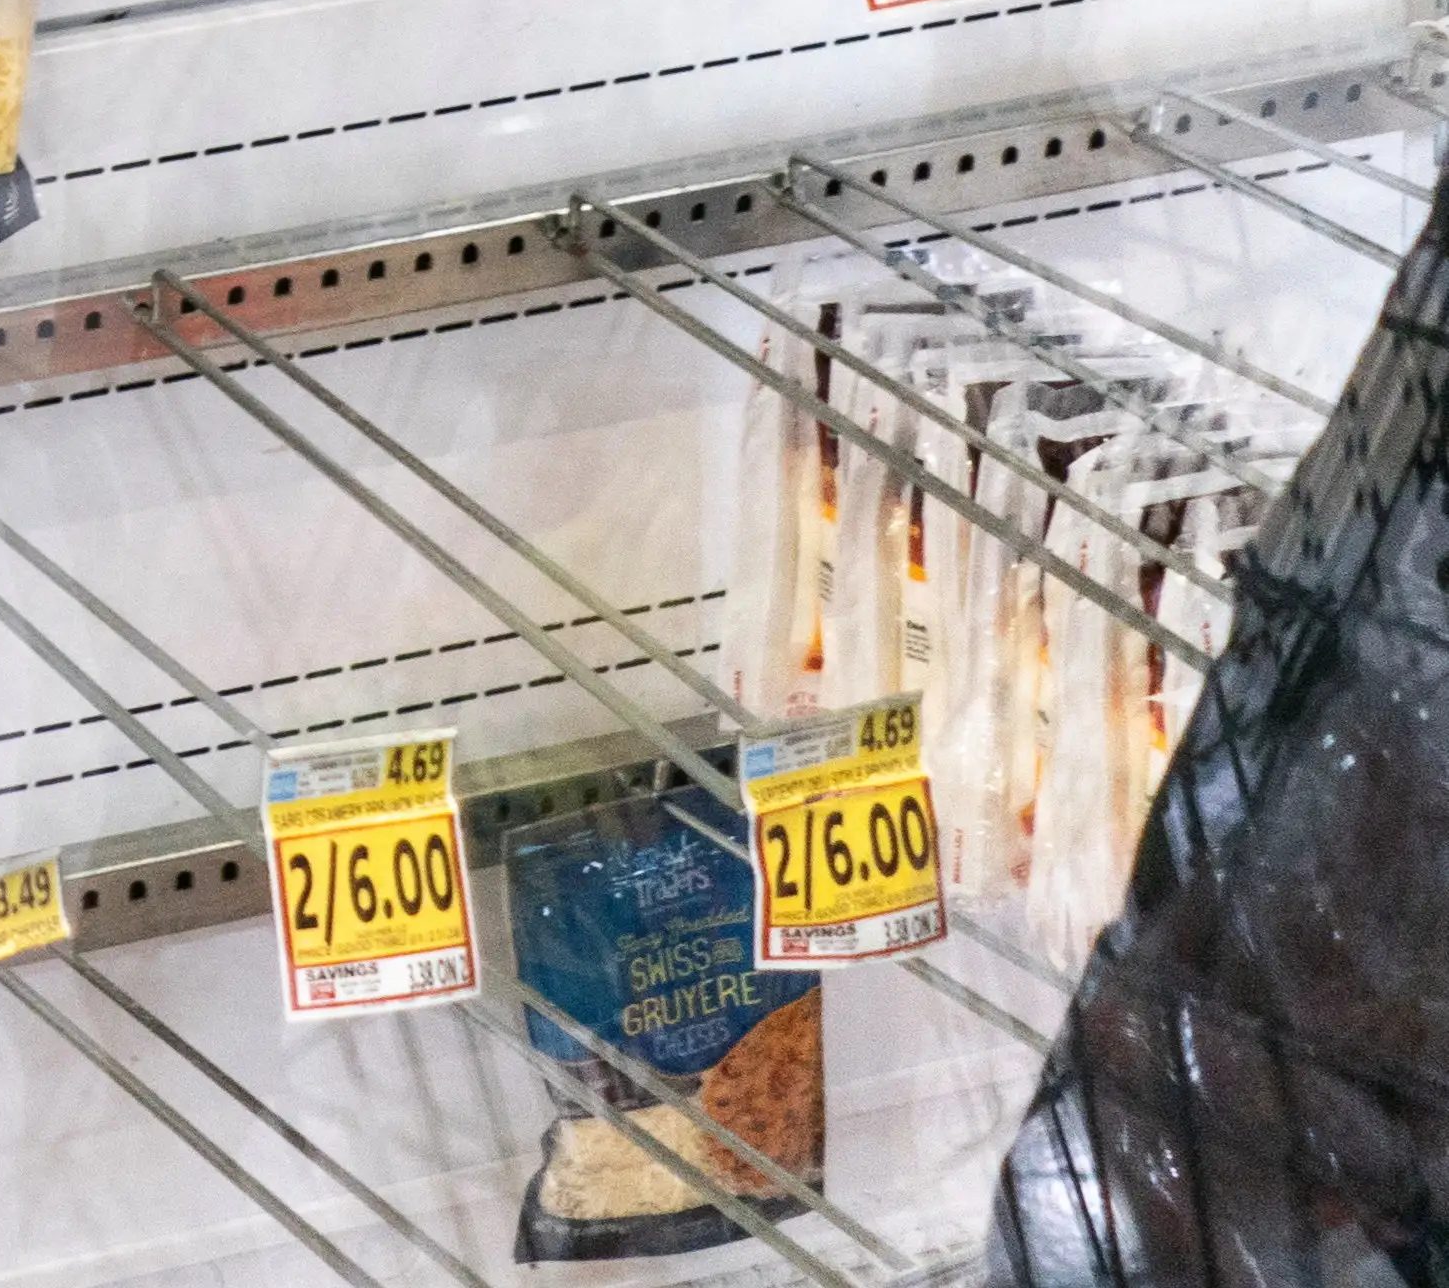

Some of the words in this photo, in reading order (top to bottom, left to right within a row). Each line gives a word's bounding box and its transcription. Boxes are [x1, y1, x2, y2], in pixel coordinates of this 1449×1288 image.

[861, 704, 916, 752] 4.69
[388, 741, 445, 784] 4.69
[767, 795, 930, 911] 2/6.00
[289, 834, 454, 946] 2/6.00
[781, 924, 858, 939] SAVINGS
[305, 961, 379, 983] SAVINGS
[629, 937, 710, 993] SWISS
